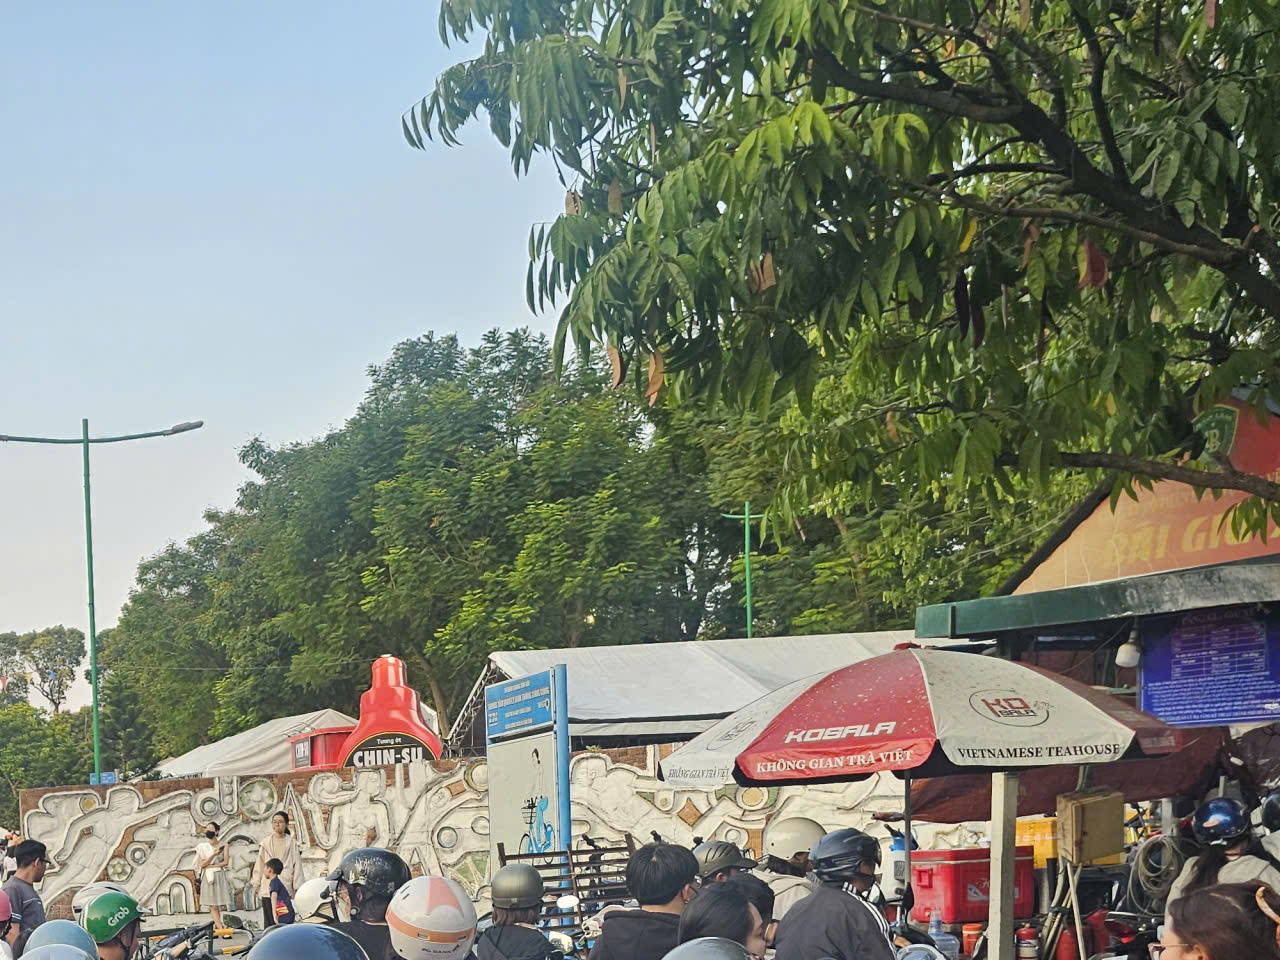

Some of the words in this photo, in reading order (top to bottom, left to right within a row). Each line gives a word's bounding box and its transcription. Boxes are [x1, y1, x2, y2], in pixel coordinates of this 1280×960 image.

[783, 721, 897, 744] KOSALA
[352, 746, 424, 767] CHIN-SU
[755, 757, 807, 773] KHÔNG
[808, 756, 846, 769] GIAN
[846, 751, 876, 767] TRÀ
[881, 748, 914, 765] VIỆT
[957, 746, 1043, 759] VIETNAMESE
[1045, 743, 1121, 757] TEAHOUSE
[108, 906, 130, 927] Grab
